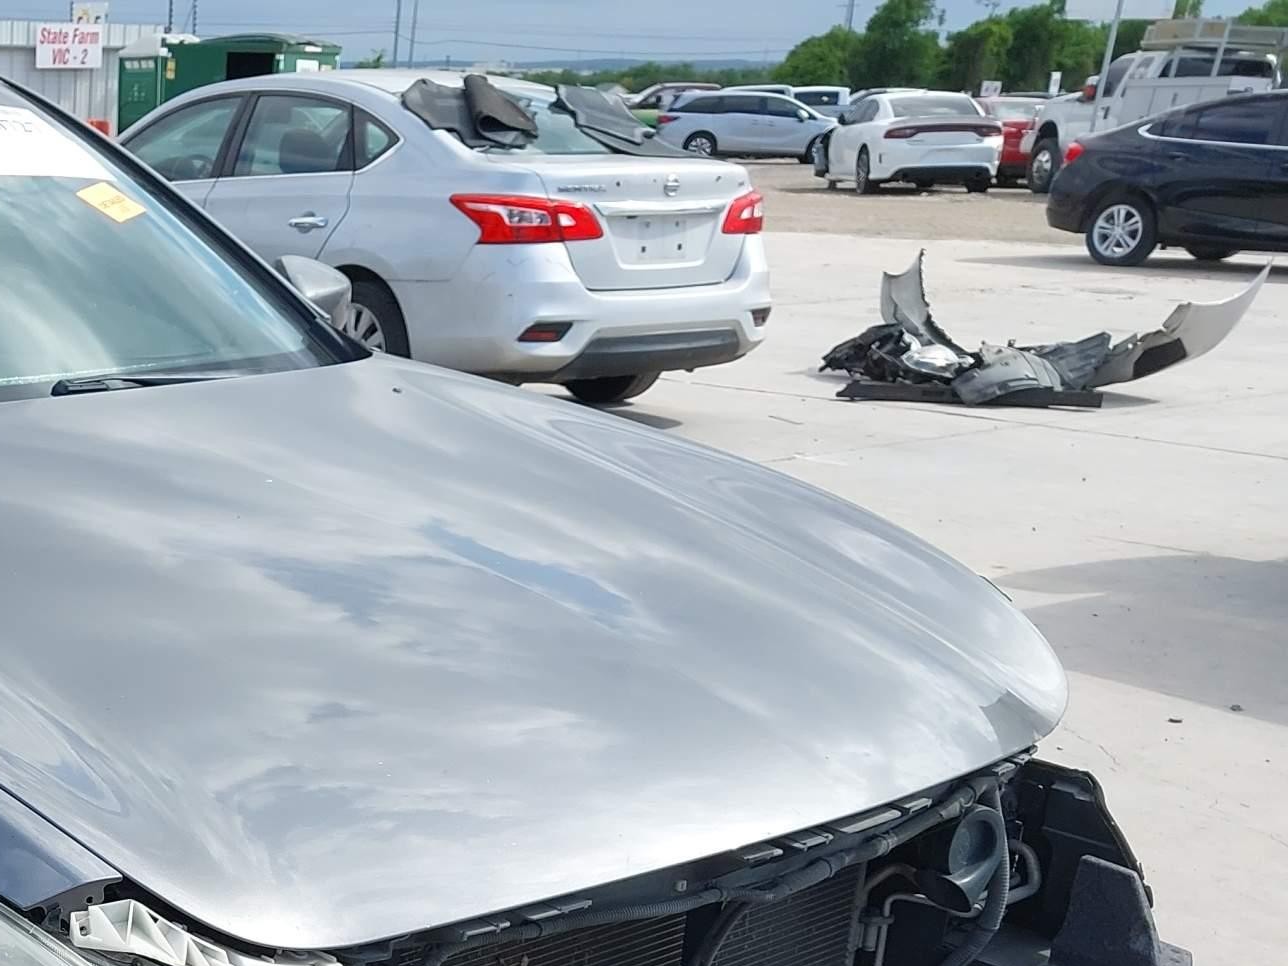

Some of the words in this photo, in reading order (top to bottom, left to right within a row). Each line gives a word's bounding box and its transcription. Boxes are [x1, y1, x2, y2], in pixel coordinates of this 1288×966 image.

[39, 27, 69, 45] State
[72, 28, 100, 45] Farm
[52, 48, 70, 65] VIC
[80, 48, 89, 65] 2
